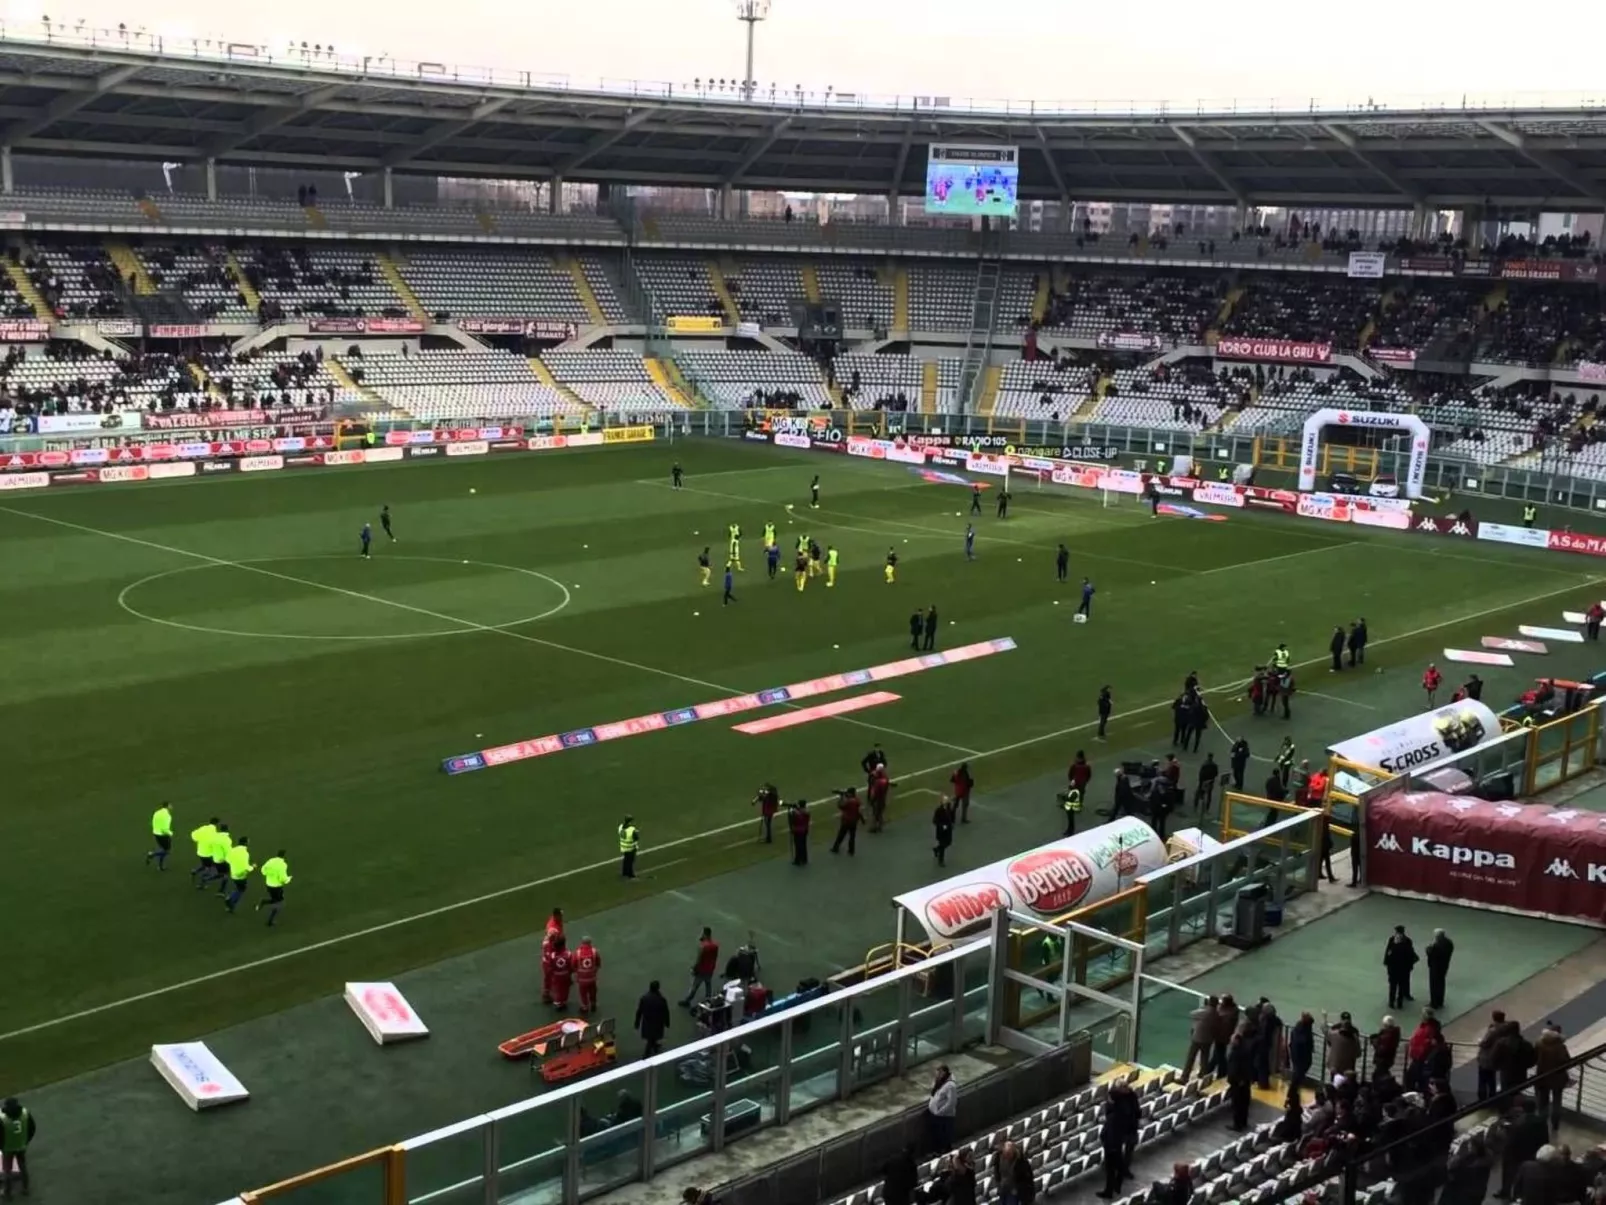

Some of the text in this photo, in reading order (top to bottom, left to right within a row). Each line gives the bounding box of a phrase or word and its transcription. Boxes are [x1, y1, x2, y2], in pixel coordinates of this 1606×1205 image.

[1218, 340, 1314, 359] TORO CLUB LA GRU
[1352, 415, 1400, 426] SUZUKI
[908, 436, 950, 446] Kappa
[962, 435, 1007, 446] RADIO 105
[1306, 433, 1315, 466] SUZUKI
[1018, 446, 1061, 457] navigare
[1072, 446, 1118, 459] CLOSE-UP
[1412, 450, 1424, 485] SUZUKI
[1412, 837, 1515, 869] Kappa
[1010, 855, 1090, 903] Beretta
[931, 886, 1003, 928] Wüber
